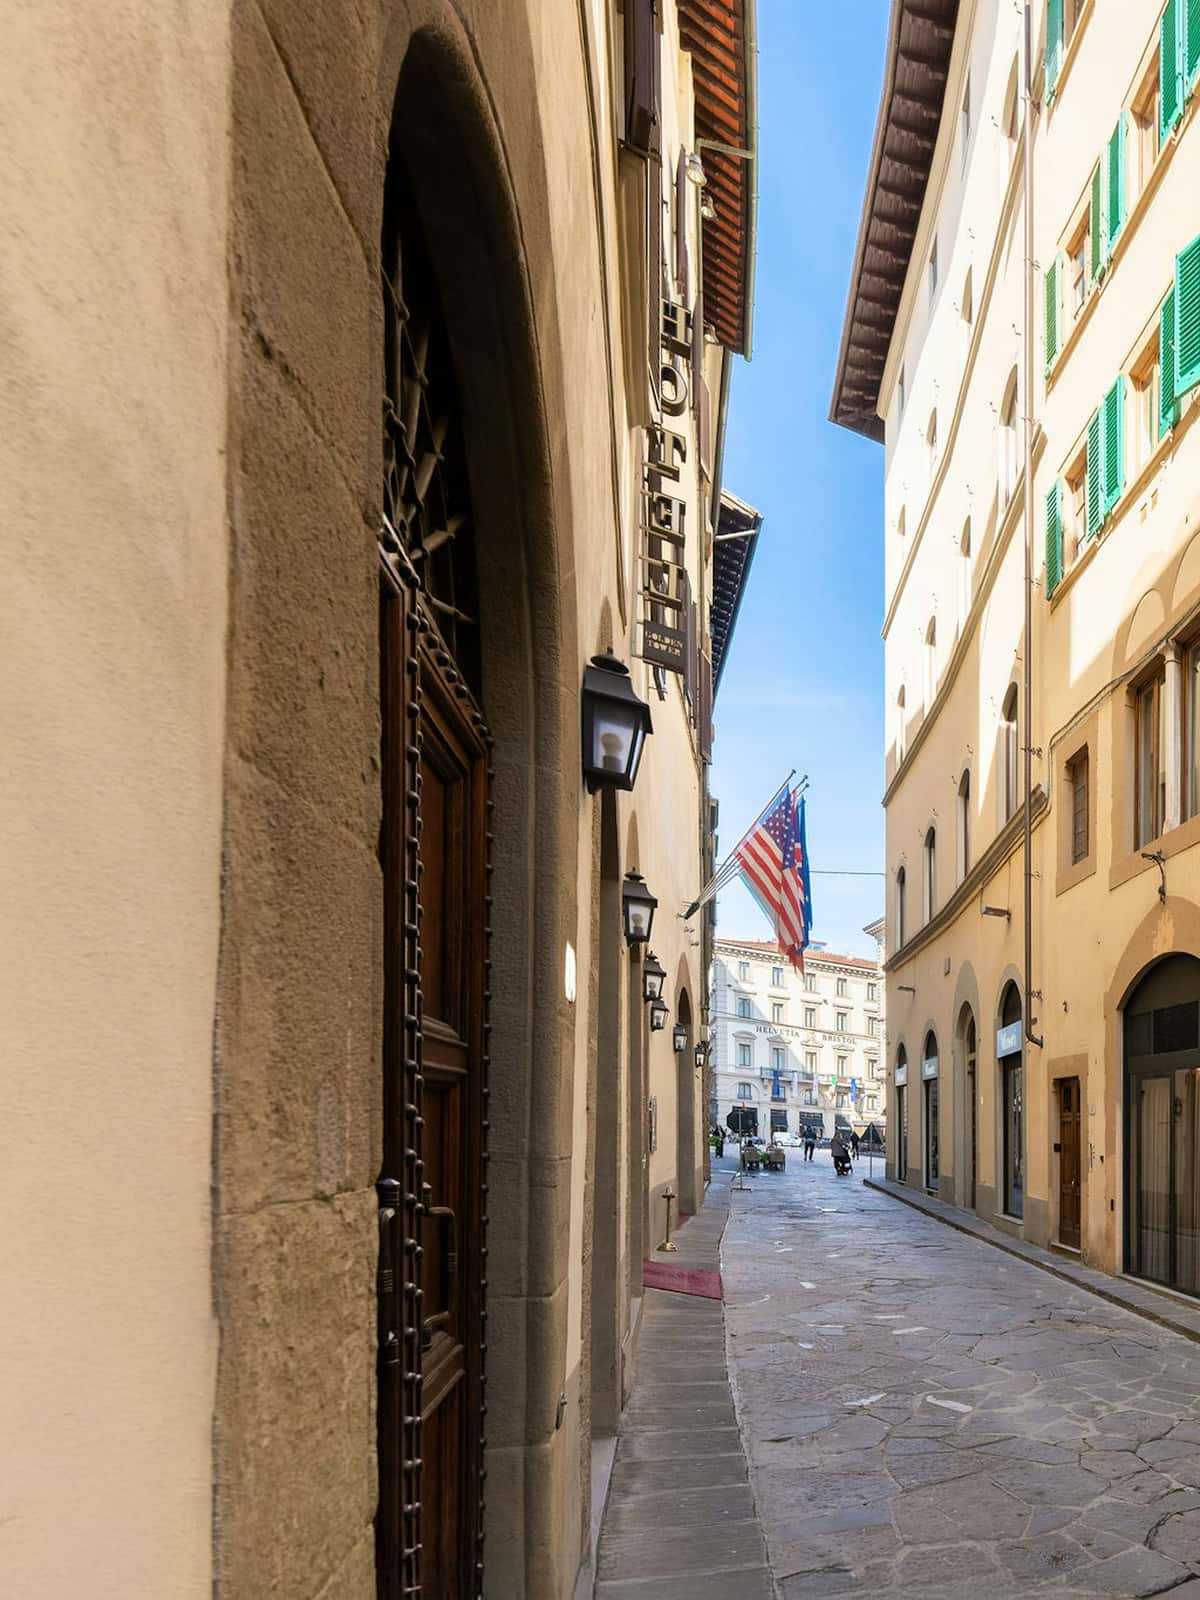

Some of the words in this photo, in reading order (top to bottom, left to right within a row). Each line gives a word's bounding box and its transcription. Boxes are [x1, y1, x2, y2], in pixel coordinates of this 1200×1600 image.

[645, 631, 683, 649] GOLDEN
[647, 639, 681, 657] TOWER
[756, 1025, 800, 1038] HELVETIA
